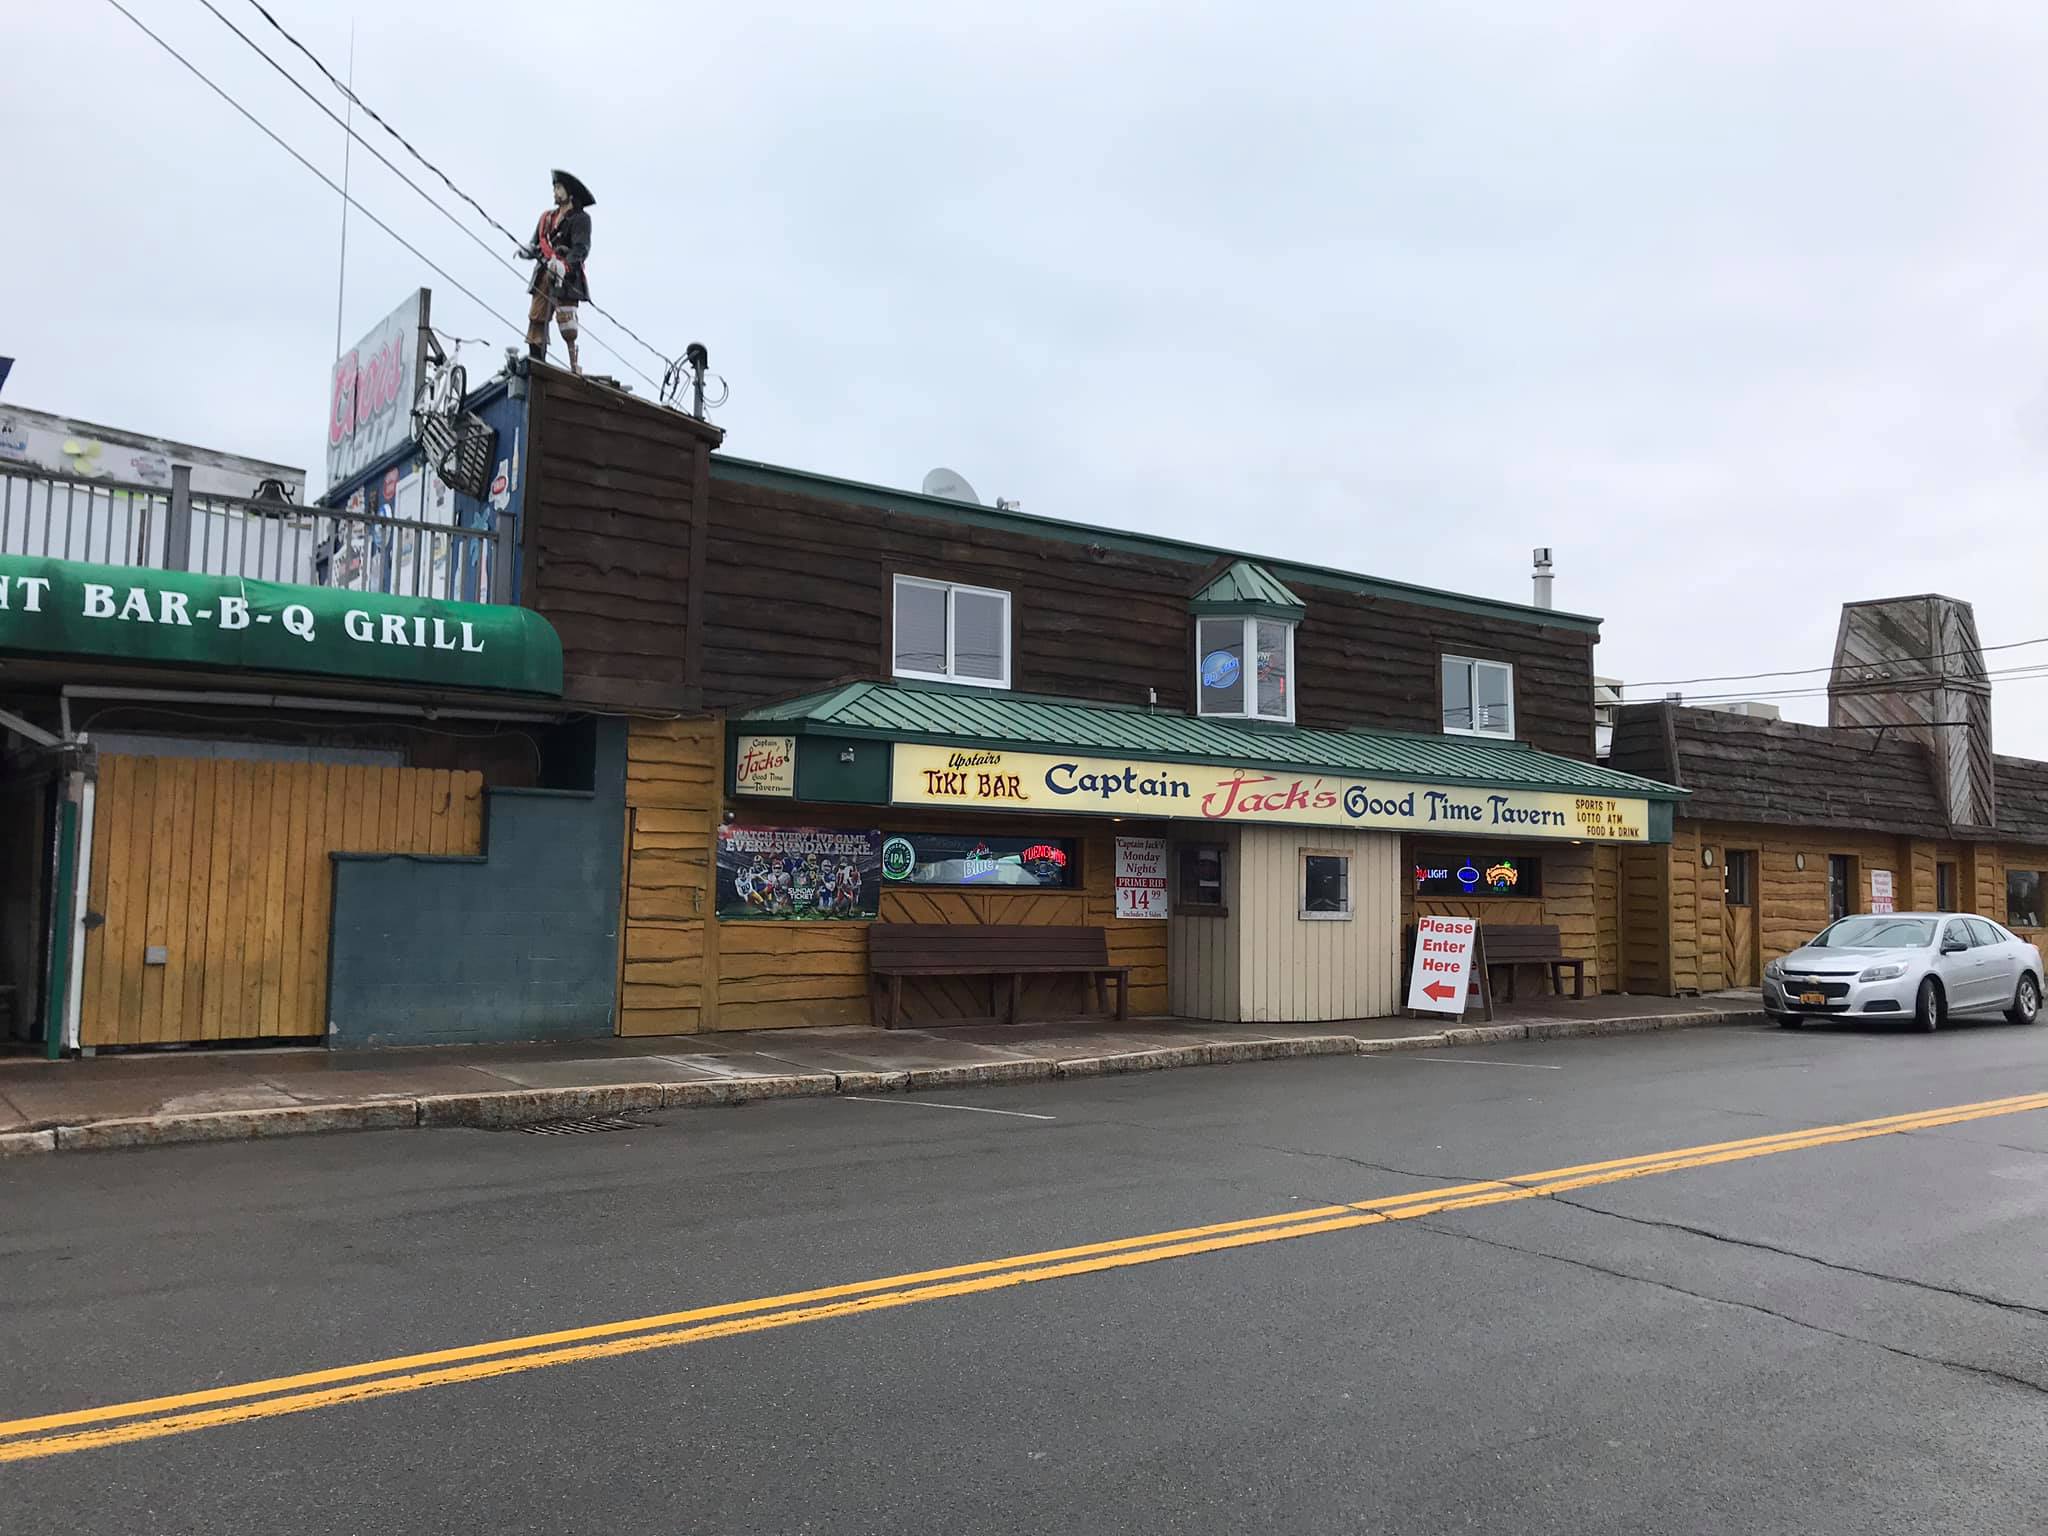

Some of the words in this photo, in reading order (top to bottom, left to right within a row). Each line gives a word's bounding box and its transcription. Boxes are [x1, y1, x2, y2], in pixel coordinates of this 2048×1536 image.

[344, 609, 485, 653] GRILL
[737, 746, 784, 782] Jack's
[948, 752, 1001, 770] Upstairs
[754, 782, 781, 792] Tavern
[923, 769, 968, 796] TIKI
[977, 773, 1029, 801] BAR
[1045, 763, 1191, 799] Captain
[1201, 768, 1337, 819] Jack's
[1343, 785, 1415, 819] Good
[1423, 790, 1483, 822] Time
[1487, 795, 1566, 826] Tavern
[1575, 799, 1604, 812] SPORTS
[1606, 801, 1617, 812] TV
[1577, 812, 1602, 823] LOTTO
[1607, 814, 1623, 825] ATM
[732, 830, 773, 841] WATCH
[774, 832, 809, 842] EVERY
[811, 833, 835, 844] LIVE
[1586, 825, 1606, 837] FOOD
[1609, 826, 1616, 837] &
[1618, 827, 1640, 838] DRINK
[726, 839, 773, 853] EVERY
[774, 840, 833, 856] SUNDAY
[890, 853, 905, 865] IPA
[1123, 850, 1161, 865] Monday
[964, 859, 994, 879] Blue
[1125, 863, 1157, 877] Nights
[1427, 869, 1449, 879] LIGHT
[1119, 877, 1149, 888] PRIME
[1149, 879, 1165, 888] RIB
[1420, 919, 1474, 934] Please
[1423, 939, 1466, 954] Enter
[1423, 958, 1461, 973] Here
